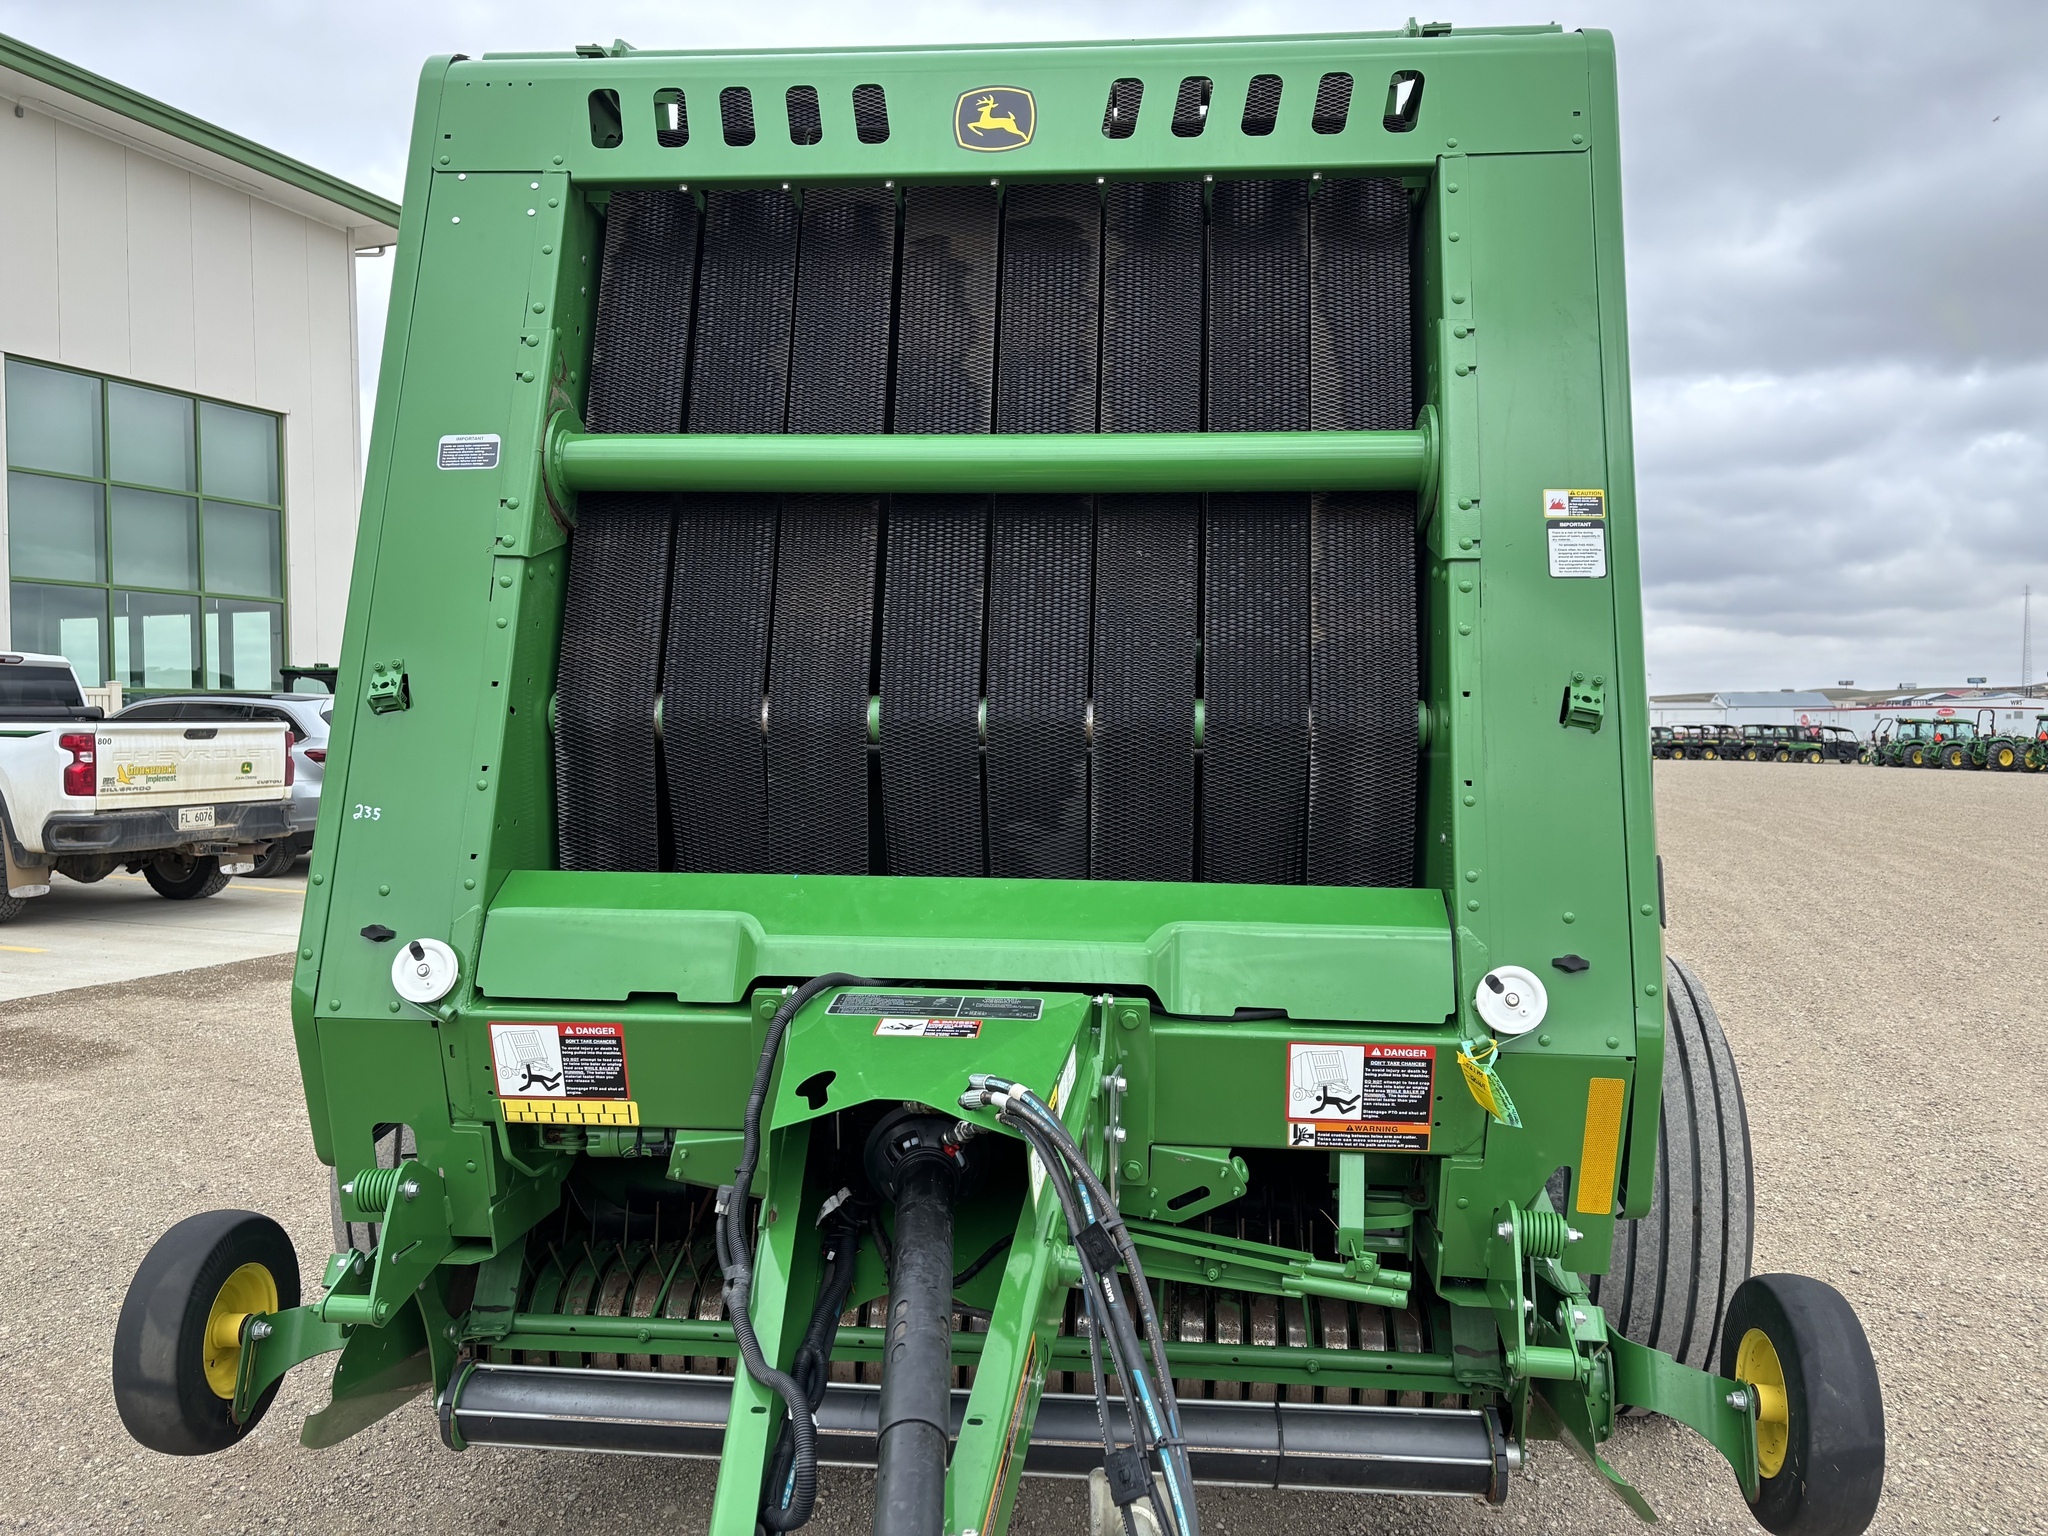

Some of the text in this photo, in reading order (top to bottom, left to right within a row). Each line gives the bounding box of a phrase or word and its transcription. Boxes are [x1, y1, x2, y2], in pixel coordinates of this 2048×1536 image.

[113, 748, 275, 762] CHEVROLET
[146, 775, 176, 784] Implement
[181, 812, 212, 823] FL 6076
[353, 804, 381, 821] 235
[1384, 1049, 1426, 1057] DANGER
[1103, 1278, 1115, 1302] GATES
